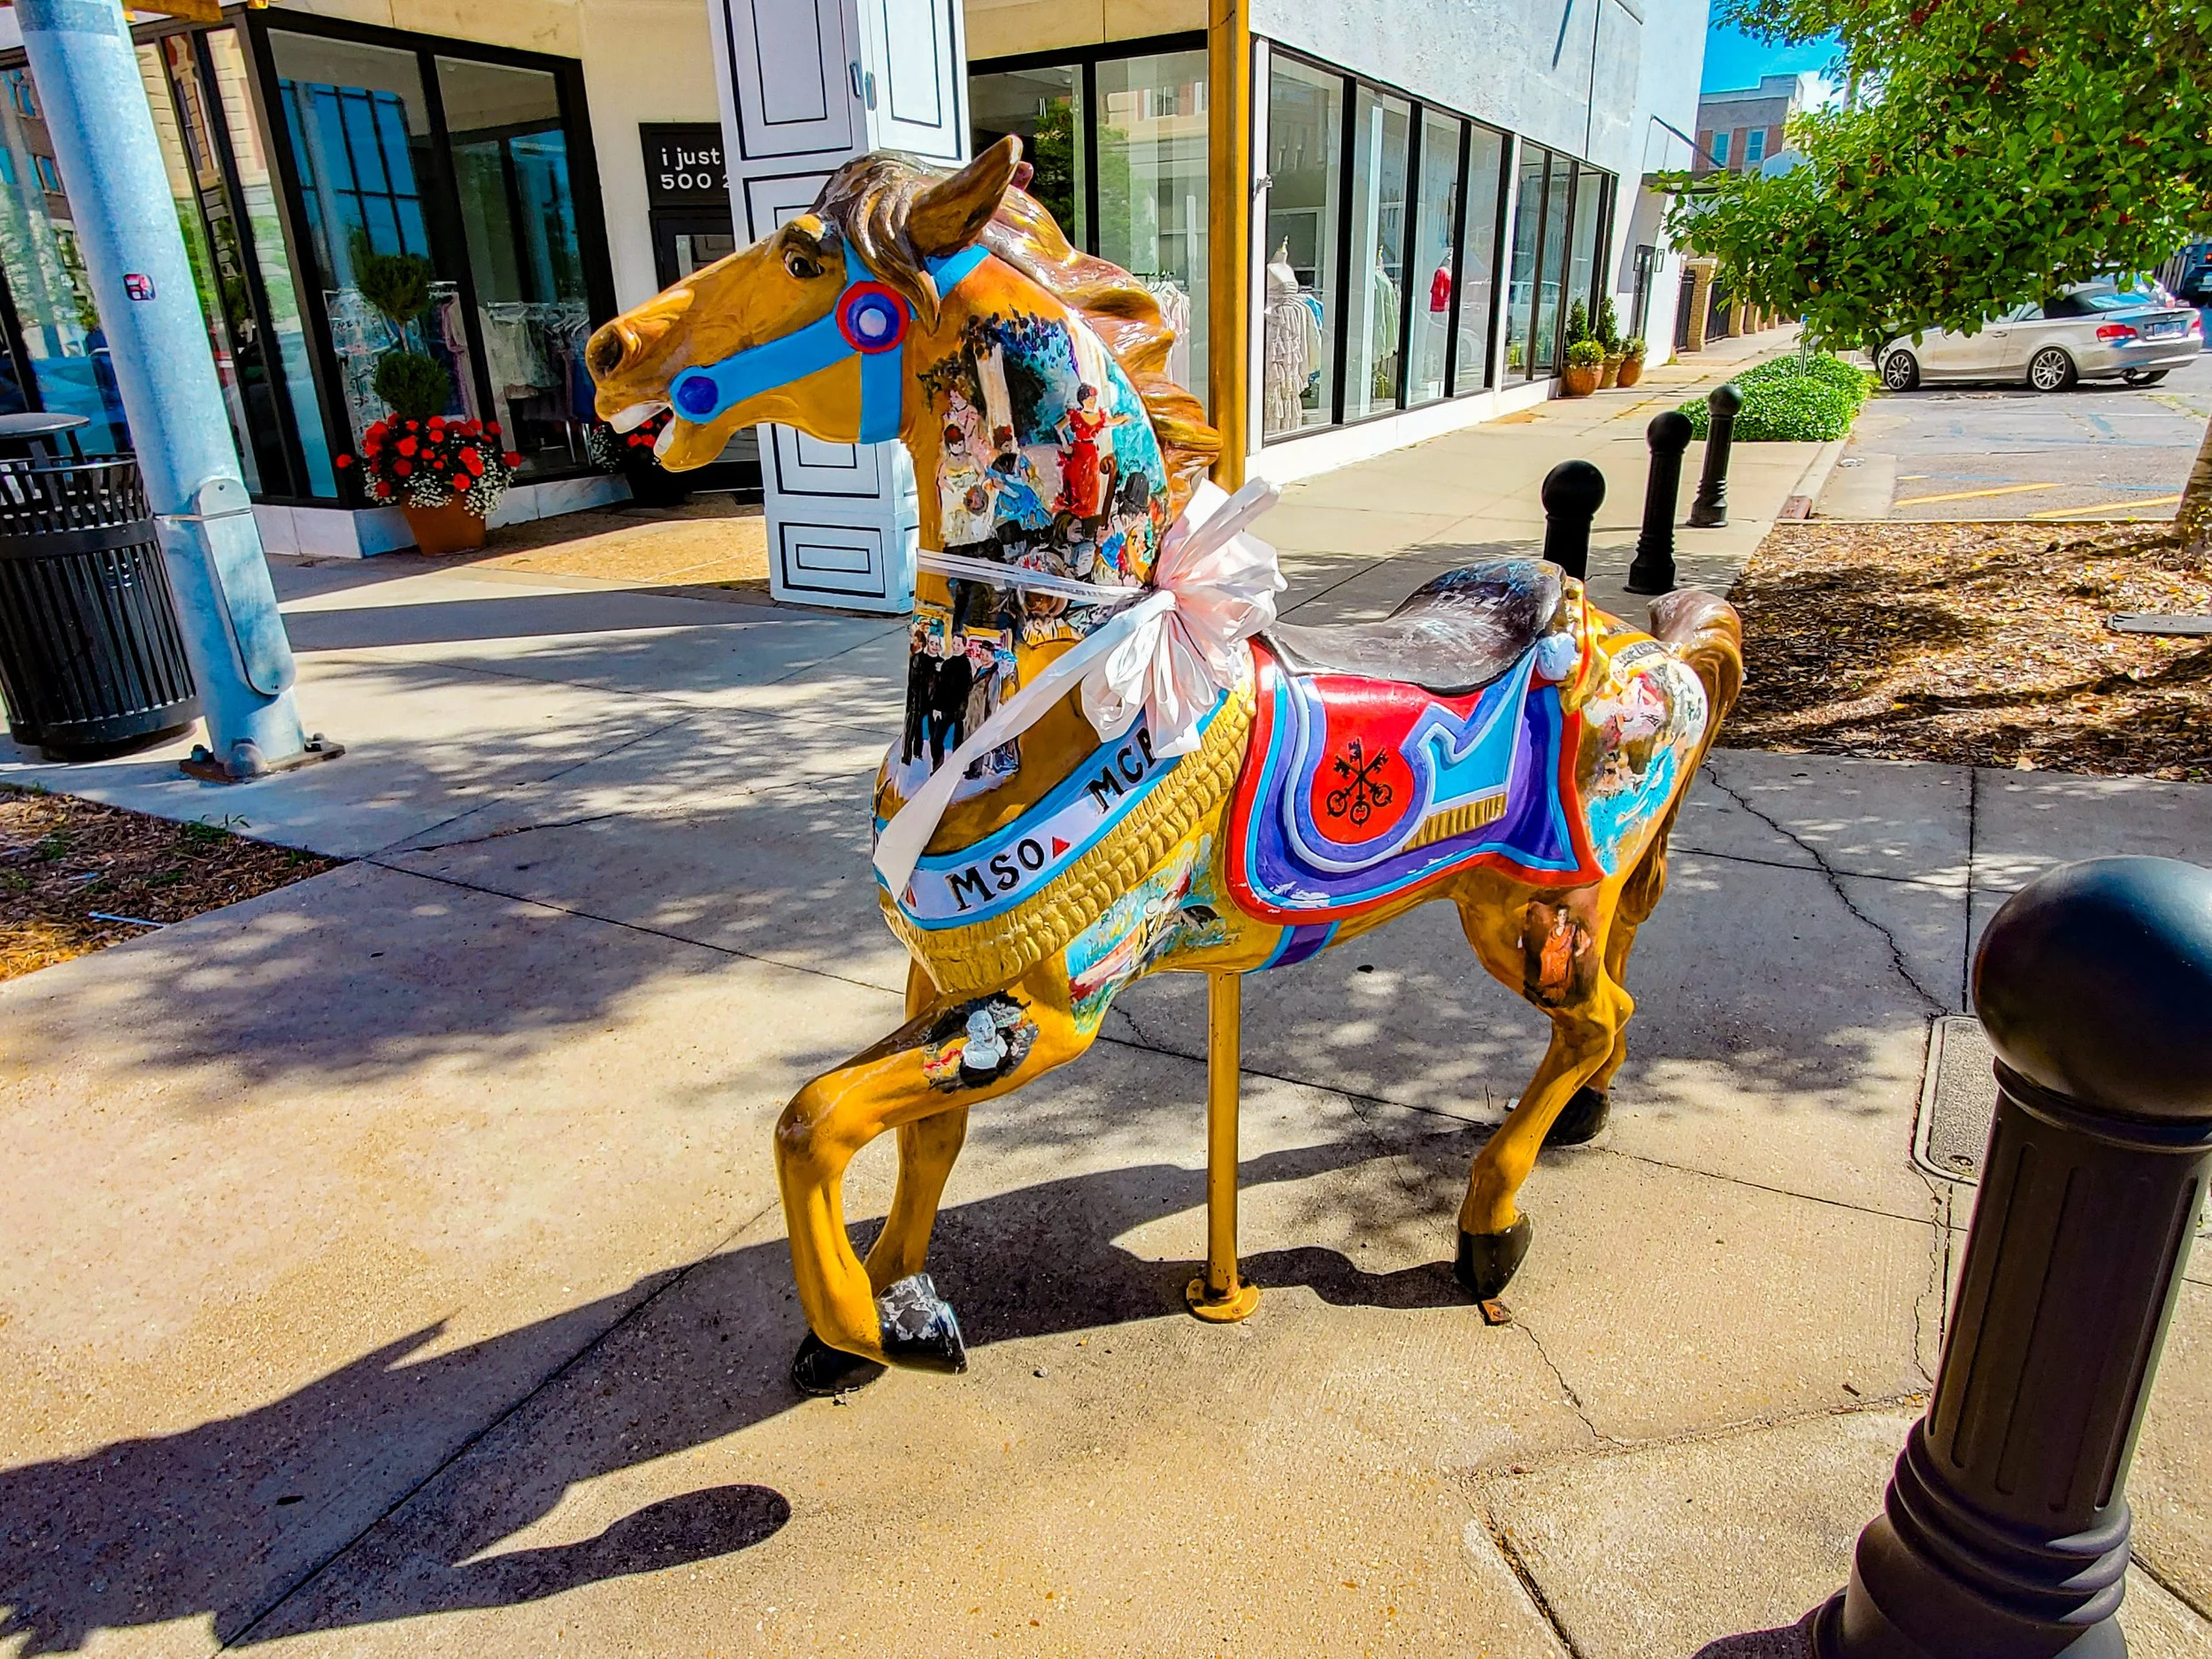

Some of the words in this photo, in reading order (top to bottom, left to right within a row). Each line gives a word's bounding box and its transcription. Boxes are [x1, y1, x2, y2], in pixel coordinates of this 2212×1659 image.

[661, 148, 668, 166] i
[675, 147, 721, 171] just
[660, 173, 712, 190] 500
[944, 838, 1044, 911] MSO
